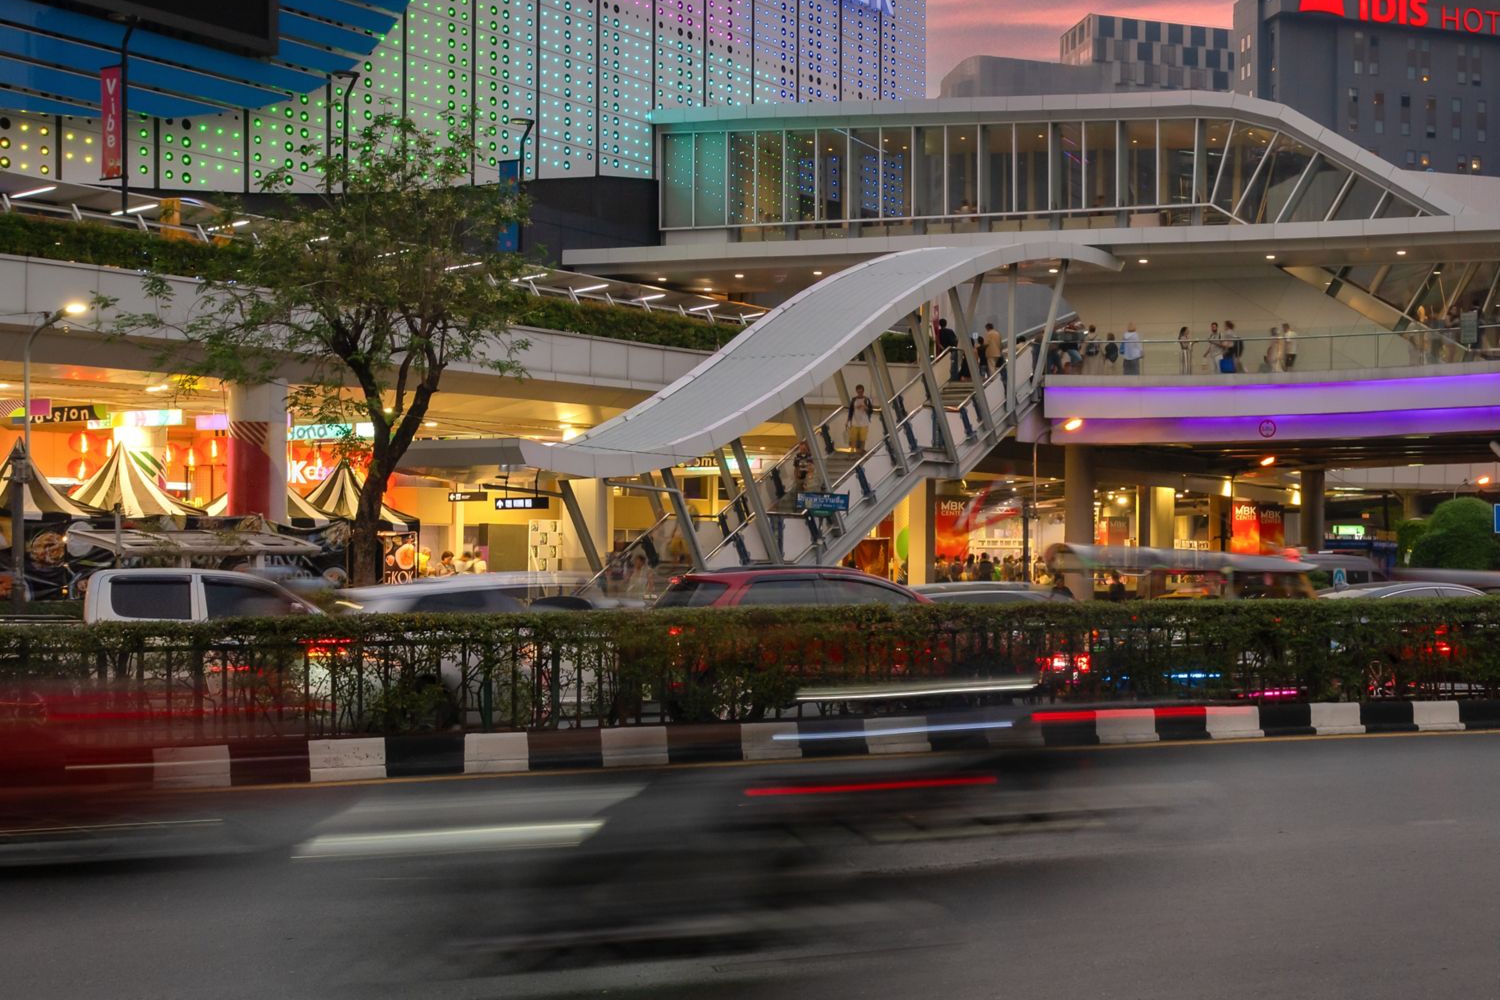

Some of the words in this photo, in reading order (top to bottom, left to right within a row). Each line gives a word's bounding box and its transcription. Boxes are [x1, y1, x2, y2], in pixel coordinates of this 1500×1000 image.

[105, 78, 117, 148] Vibe
[941, 500, 966, 511] MBK
[1235, 505, 1257, 515] MBK
